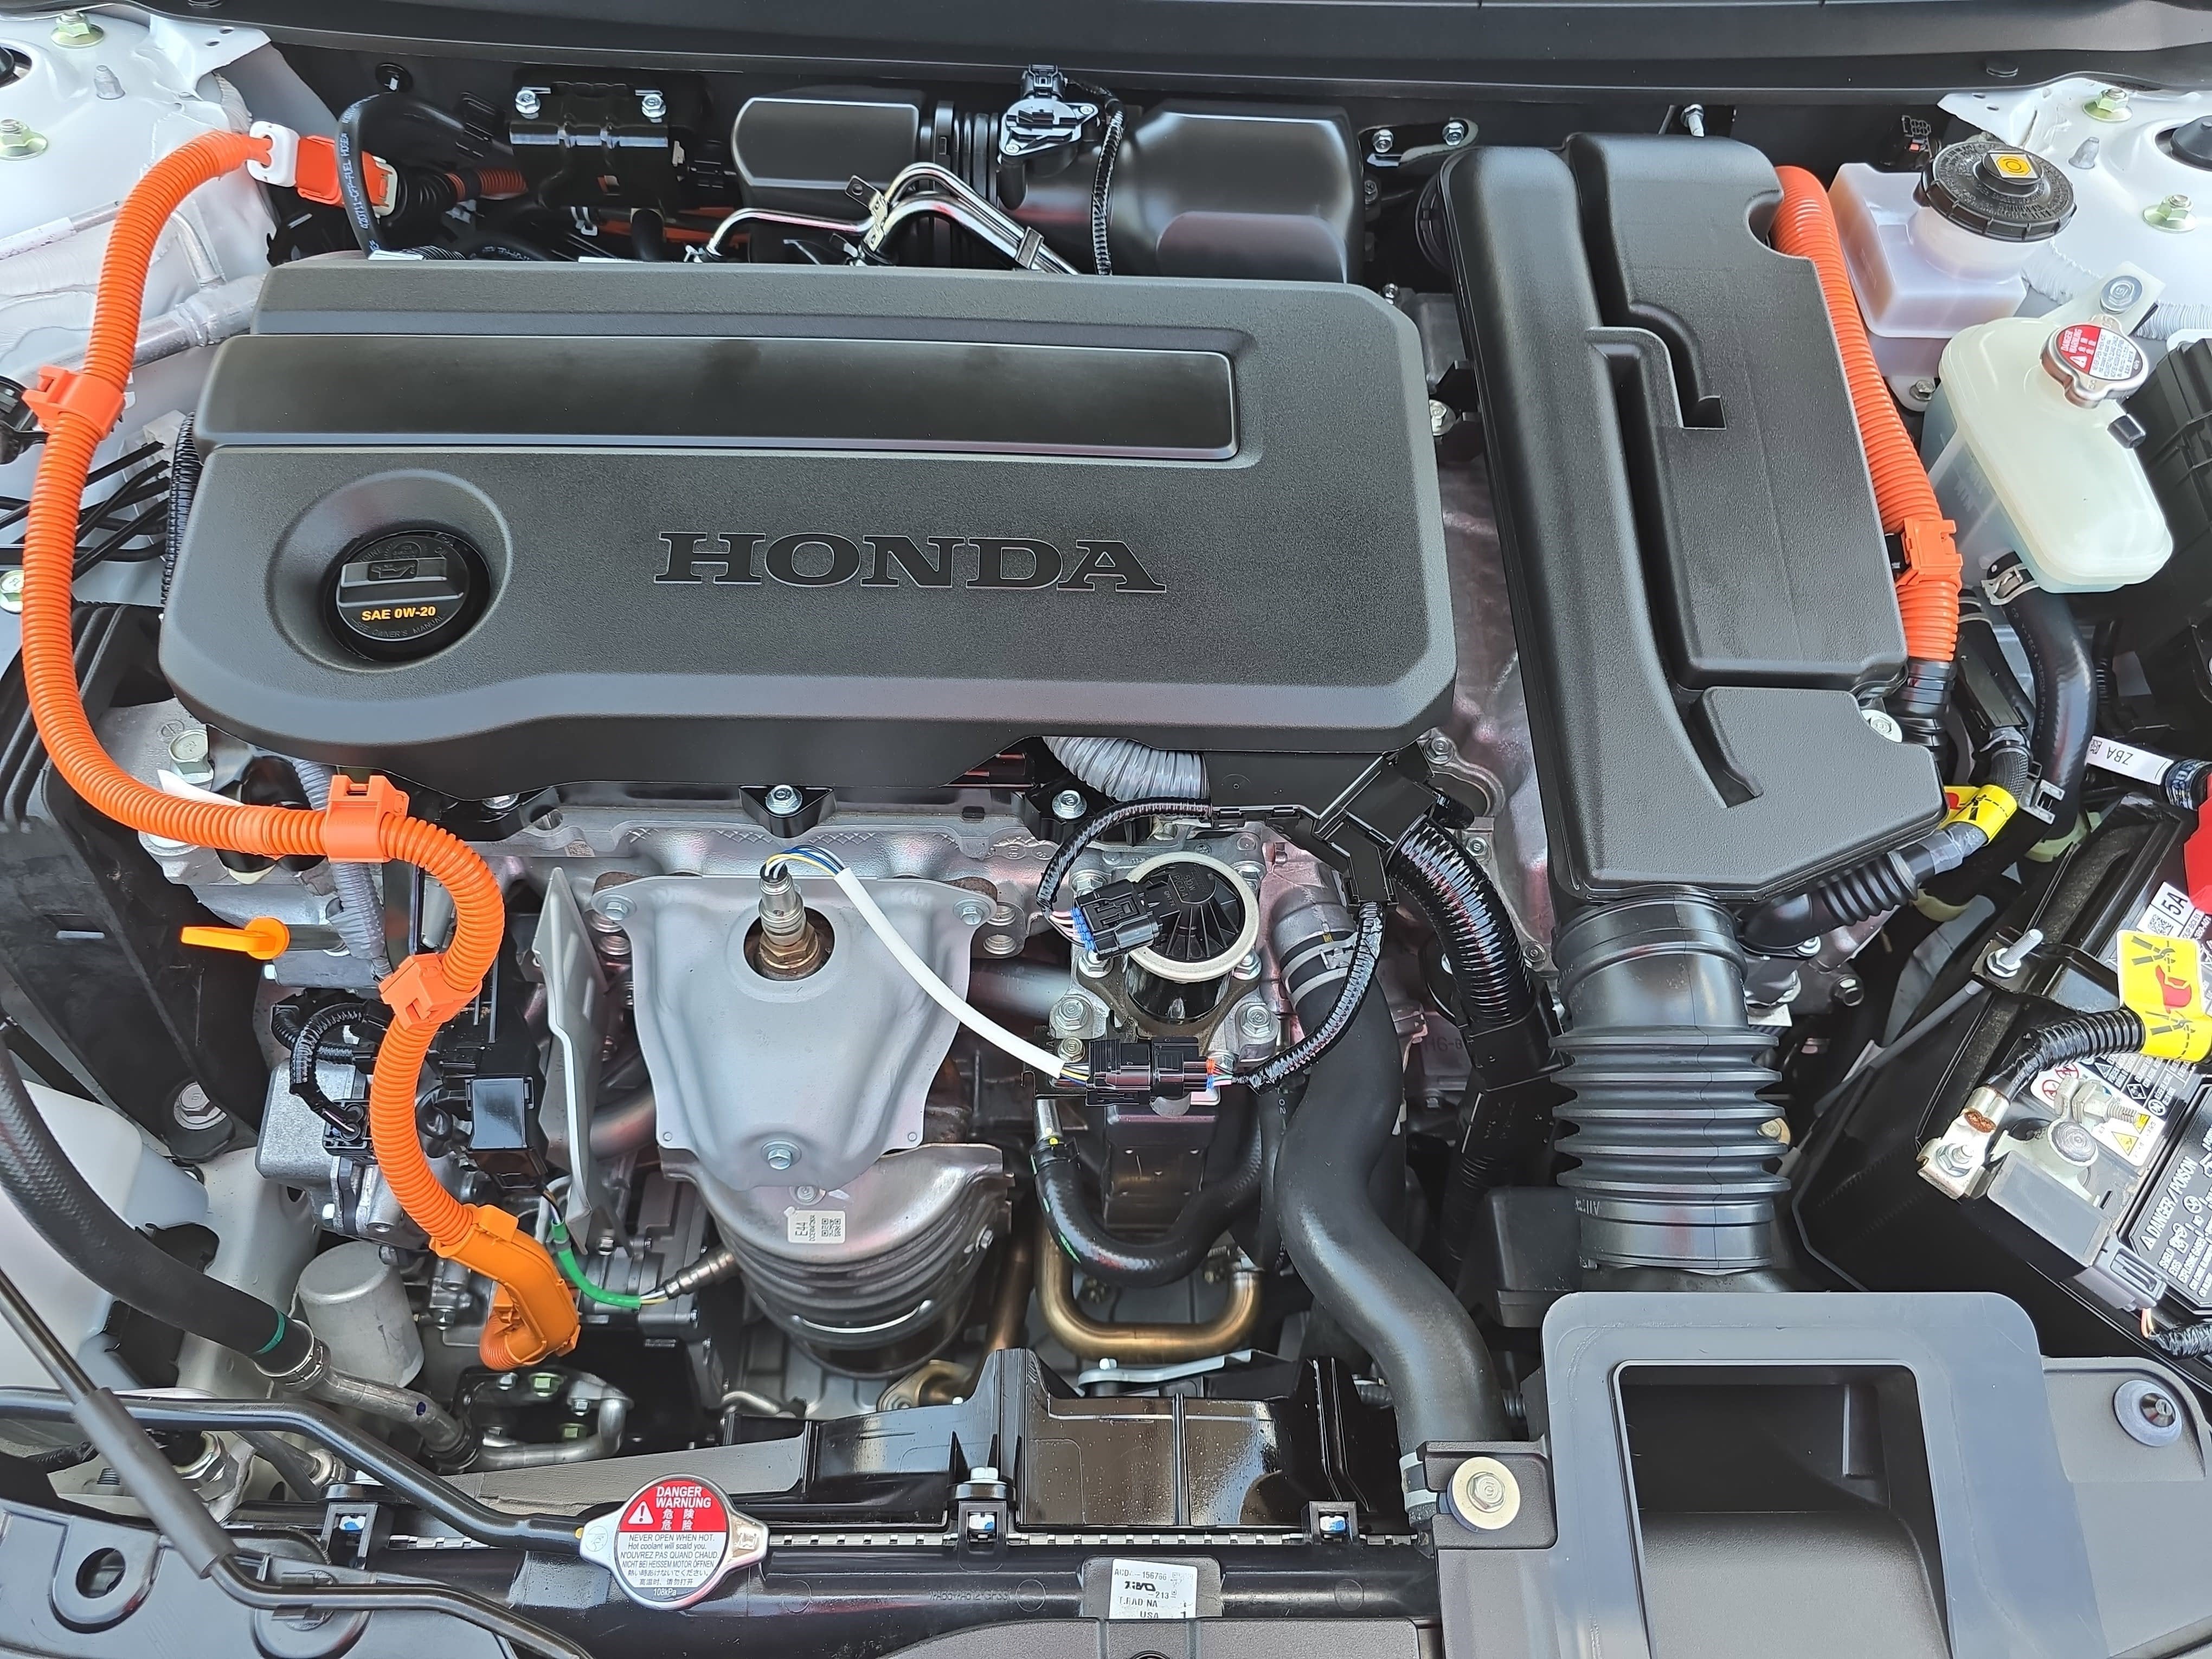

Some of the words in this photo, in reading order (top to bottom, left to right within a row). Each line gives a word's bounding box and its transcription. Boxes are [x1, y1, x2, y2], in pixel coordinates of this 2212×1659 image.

[653, 531, 1167, 593] HONDA
[361, 608, 391, 621] SAE
[394, 606, 436, 619] 0W-20
[2106, 746, 2134, 766] ZBA
[2161, 892, 2188, 916] 5A
[656, 1486, 702, 1497] DANGER
[655, 1497, 712, 1508] WARNUNG
[662, 1508, 674, 1519] 危
[661, 1520, 673, 1531] 危
[670, 1551, 693, 1559] QUAND
[653, 1587, 677, 1596] 108kPa
[1147, 1599, 1158, 1607] NA
